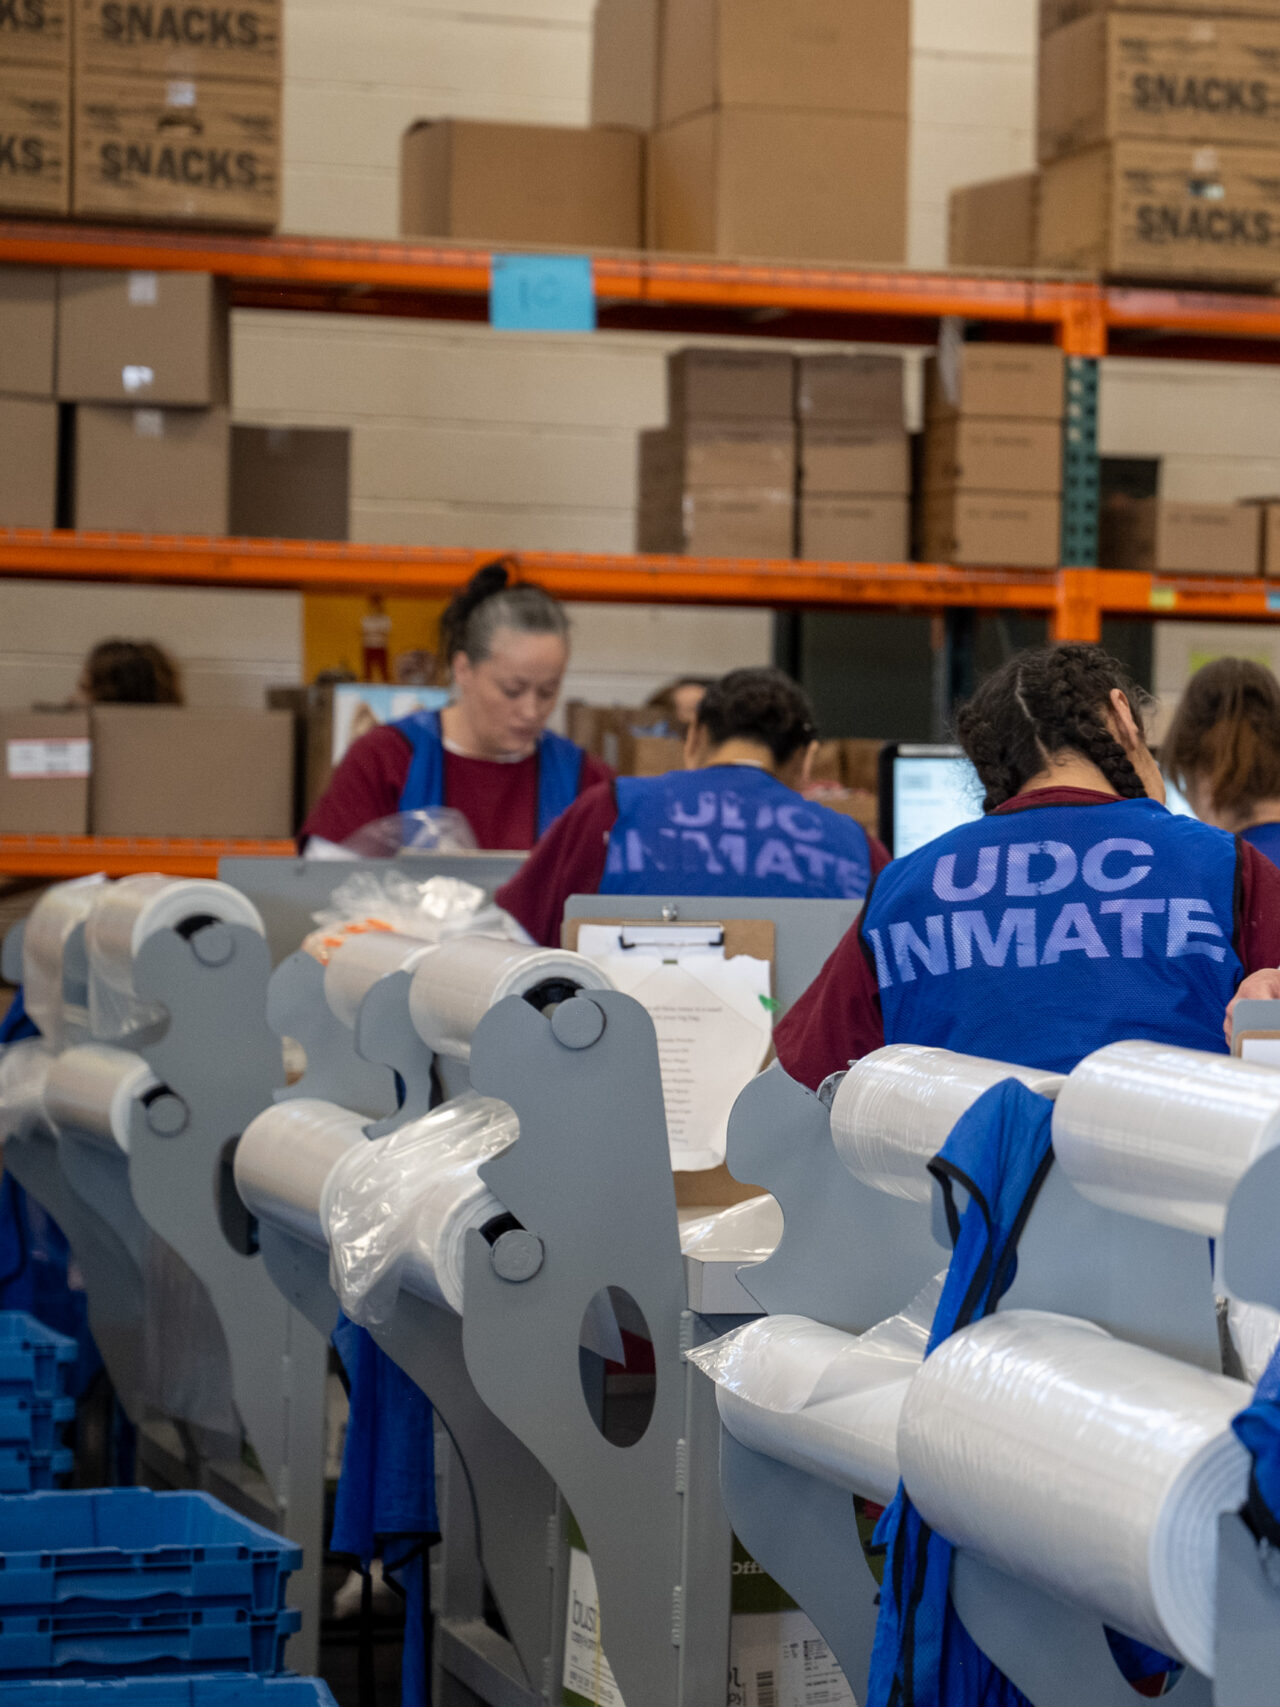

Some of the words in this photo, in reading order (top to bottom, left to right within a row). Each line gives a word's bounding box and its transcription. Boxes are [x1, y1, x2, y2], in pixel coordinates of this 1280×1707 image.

[102, 2, 260, 48] SNACKS
[1133, 73, 1269, 116] SNACKS
[101, 142, 258, 188] SNACKS
[1137, 204, 1270, 246] SNACKS
[932, 837, 1155, 901] UDC
[868, 898, 1227, 989] INMATE
